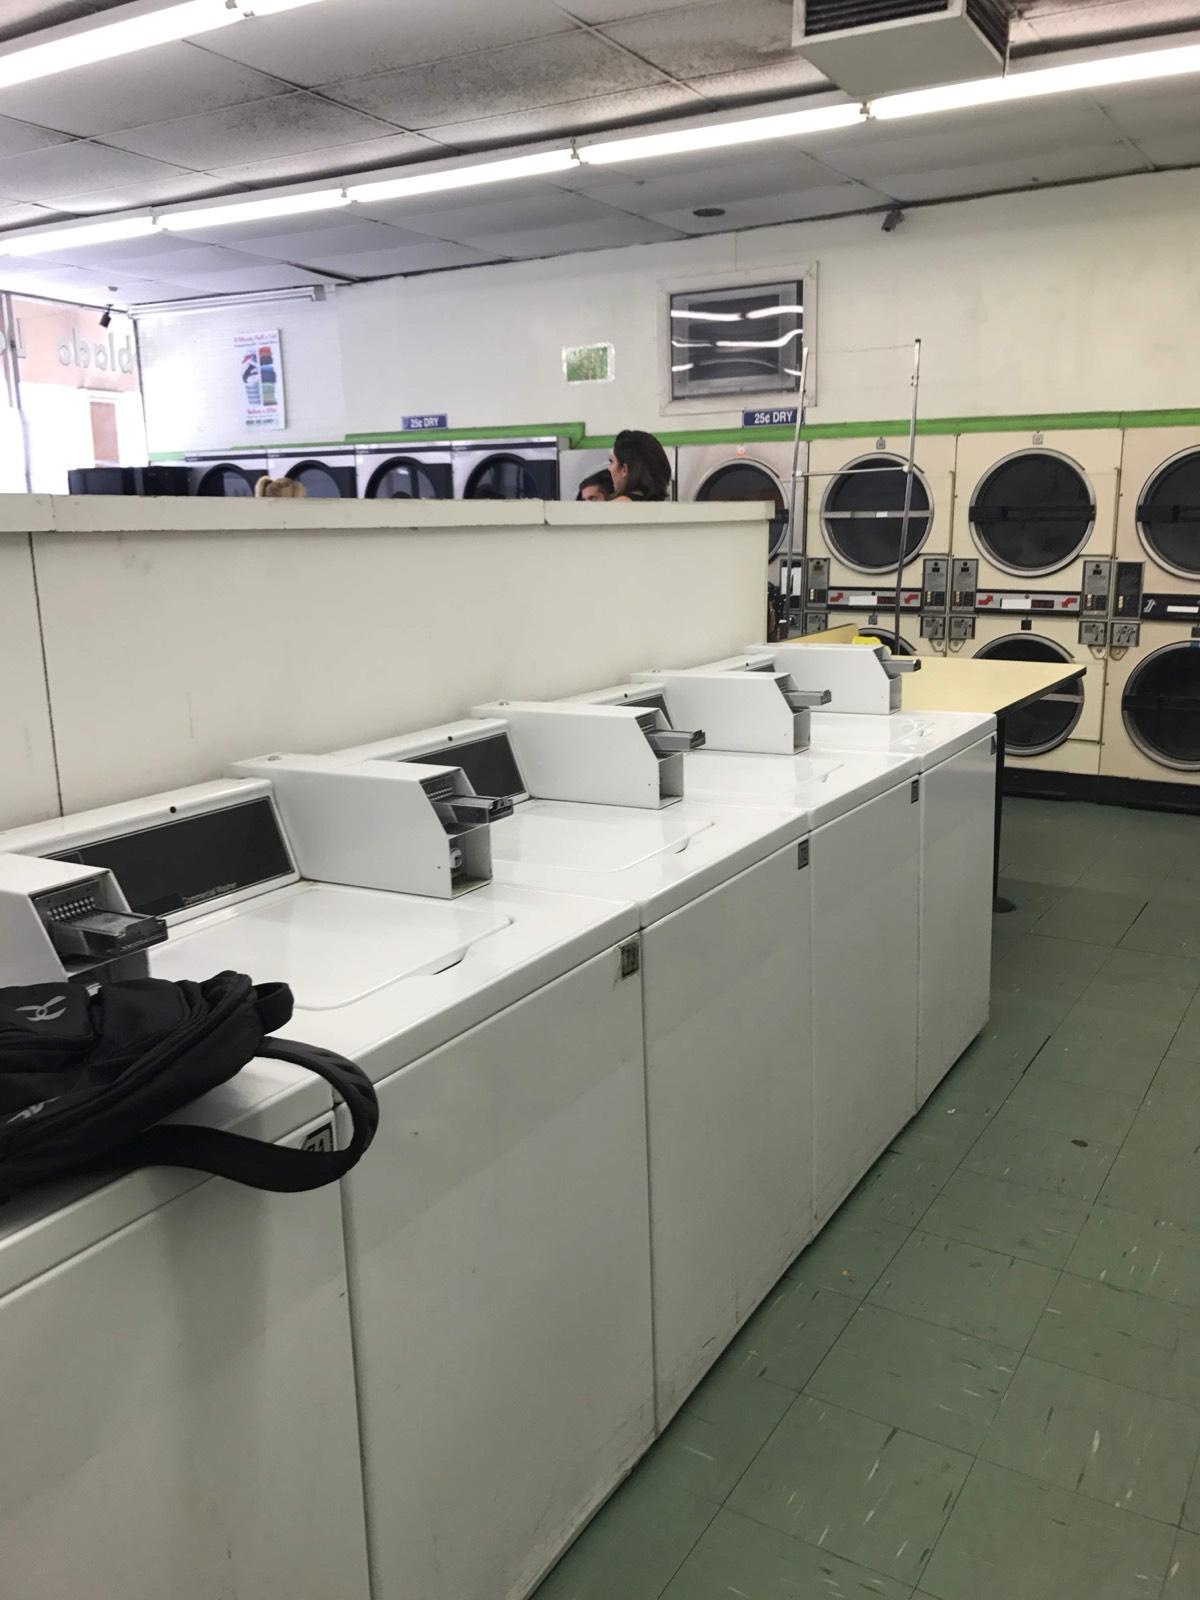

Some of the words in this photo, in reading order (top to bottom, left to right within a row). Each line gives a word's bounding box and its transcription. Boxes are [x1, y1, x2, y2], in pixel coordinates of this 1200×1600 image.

[423, 417, 439, 427] DRY
[754, 412, 771, 424] 25¢
[772, 410, 793, 423] DRY
